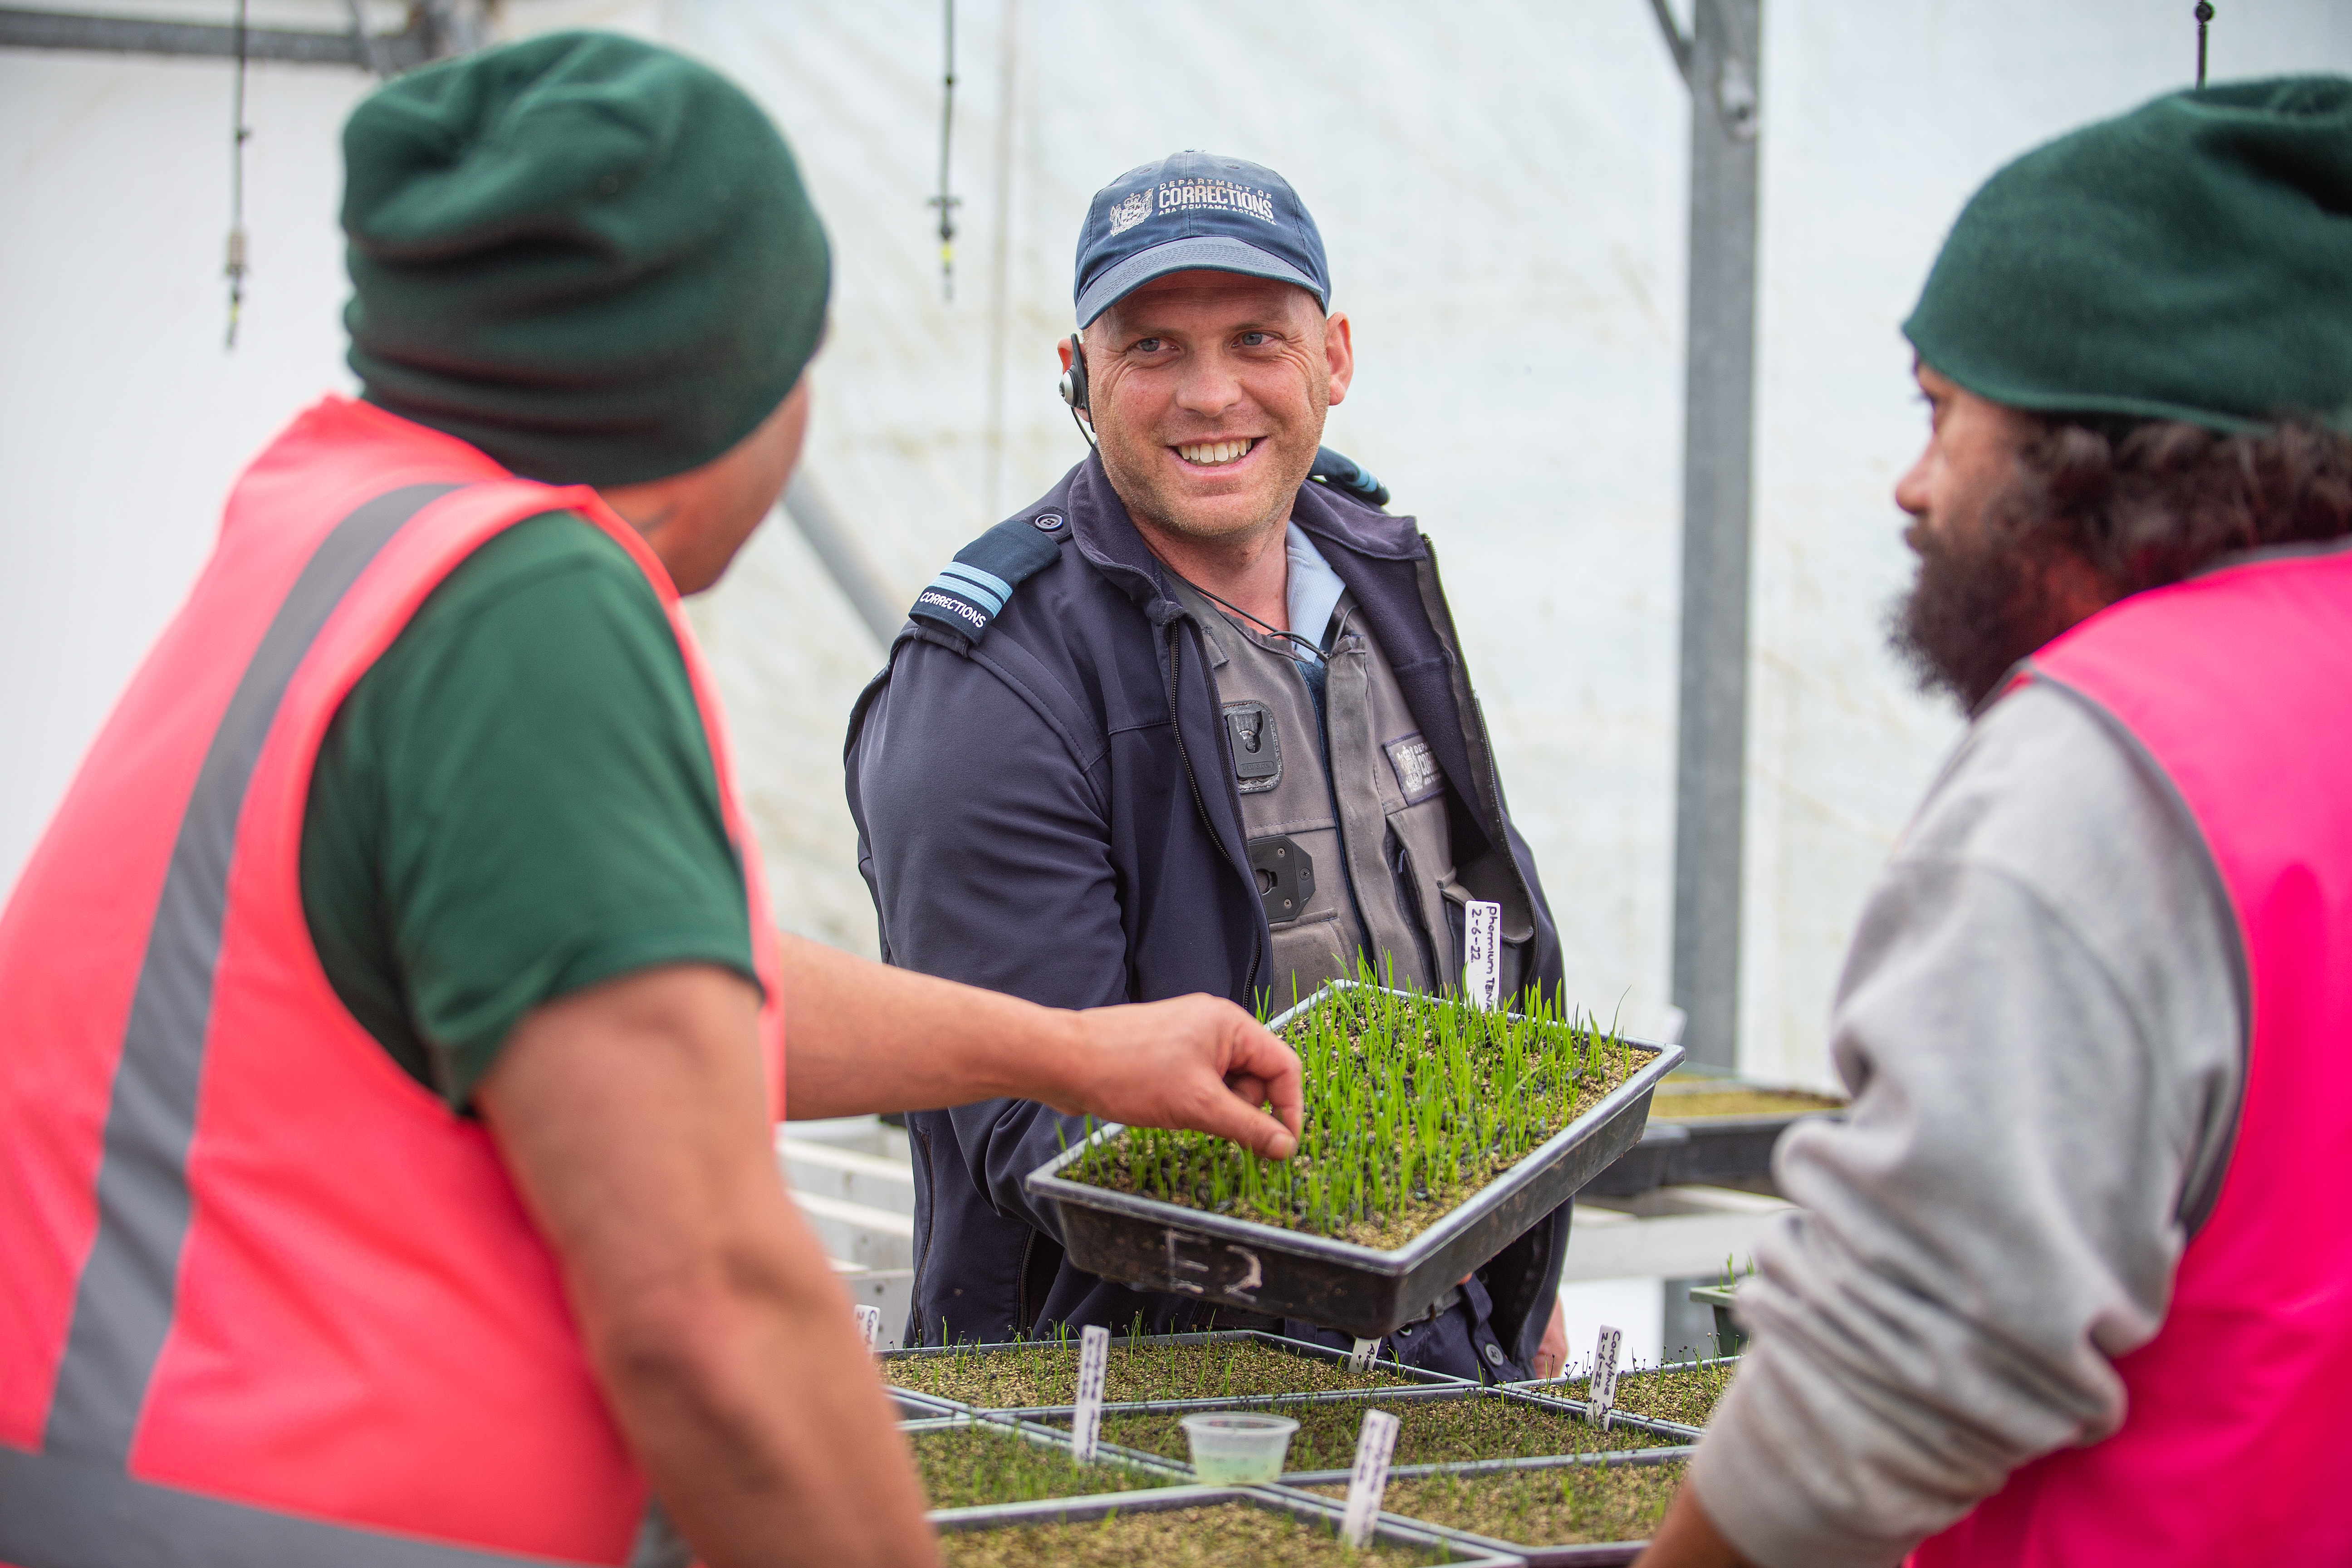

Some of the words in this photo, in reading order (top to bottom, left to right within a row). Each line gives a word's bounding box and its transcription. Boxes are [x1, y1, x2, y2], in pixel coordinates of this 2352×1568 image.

[1158, 185, 1274, 219] CORRECTIONS
[1159, 178, 1251, 192] DEPARTMENT
[1258, 190, 1272, 199] OF
[1158, 207, 1177, 216] ARA
[919, 591, 987, 628] CORRECTIONS
[1470, 908, 1482, 963] 2-6-22
[1593, 1332, 1608, 1390] 2-6-22
[1604, 1330, 1621, 1396] Cordyline
